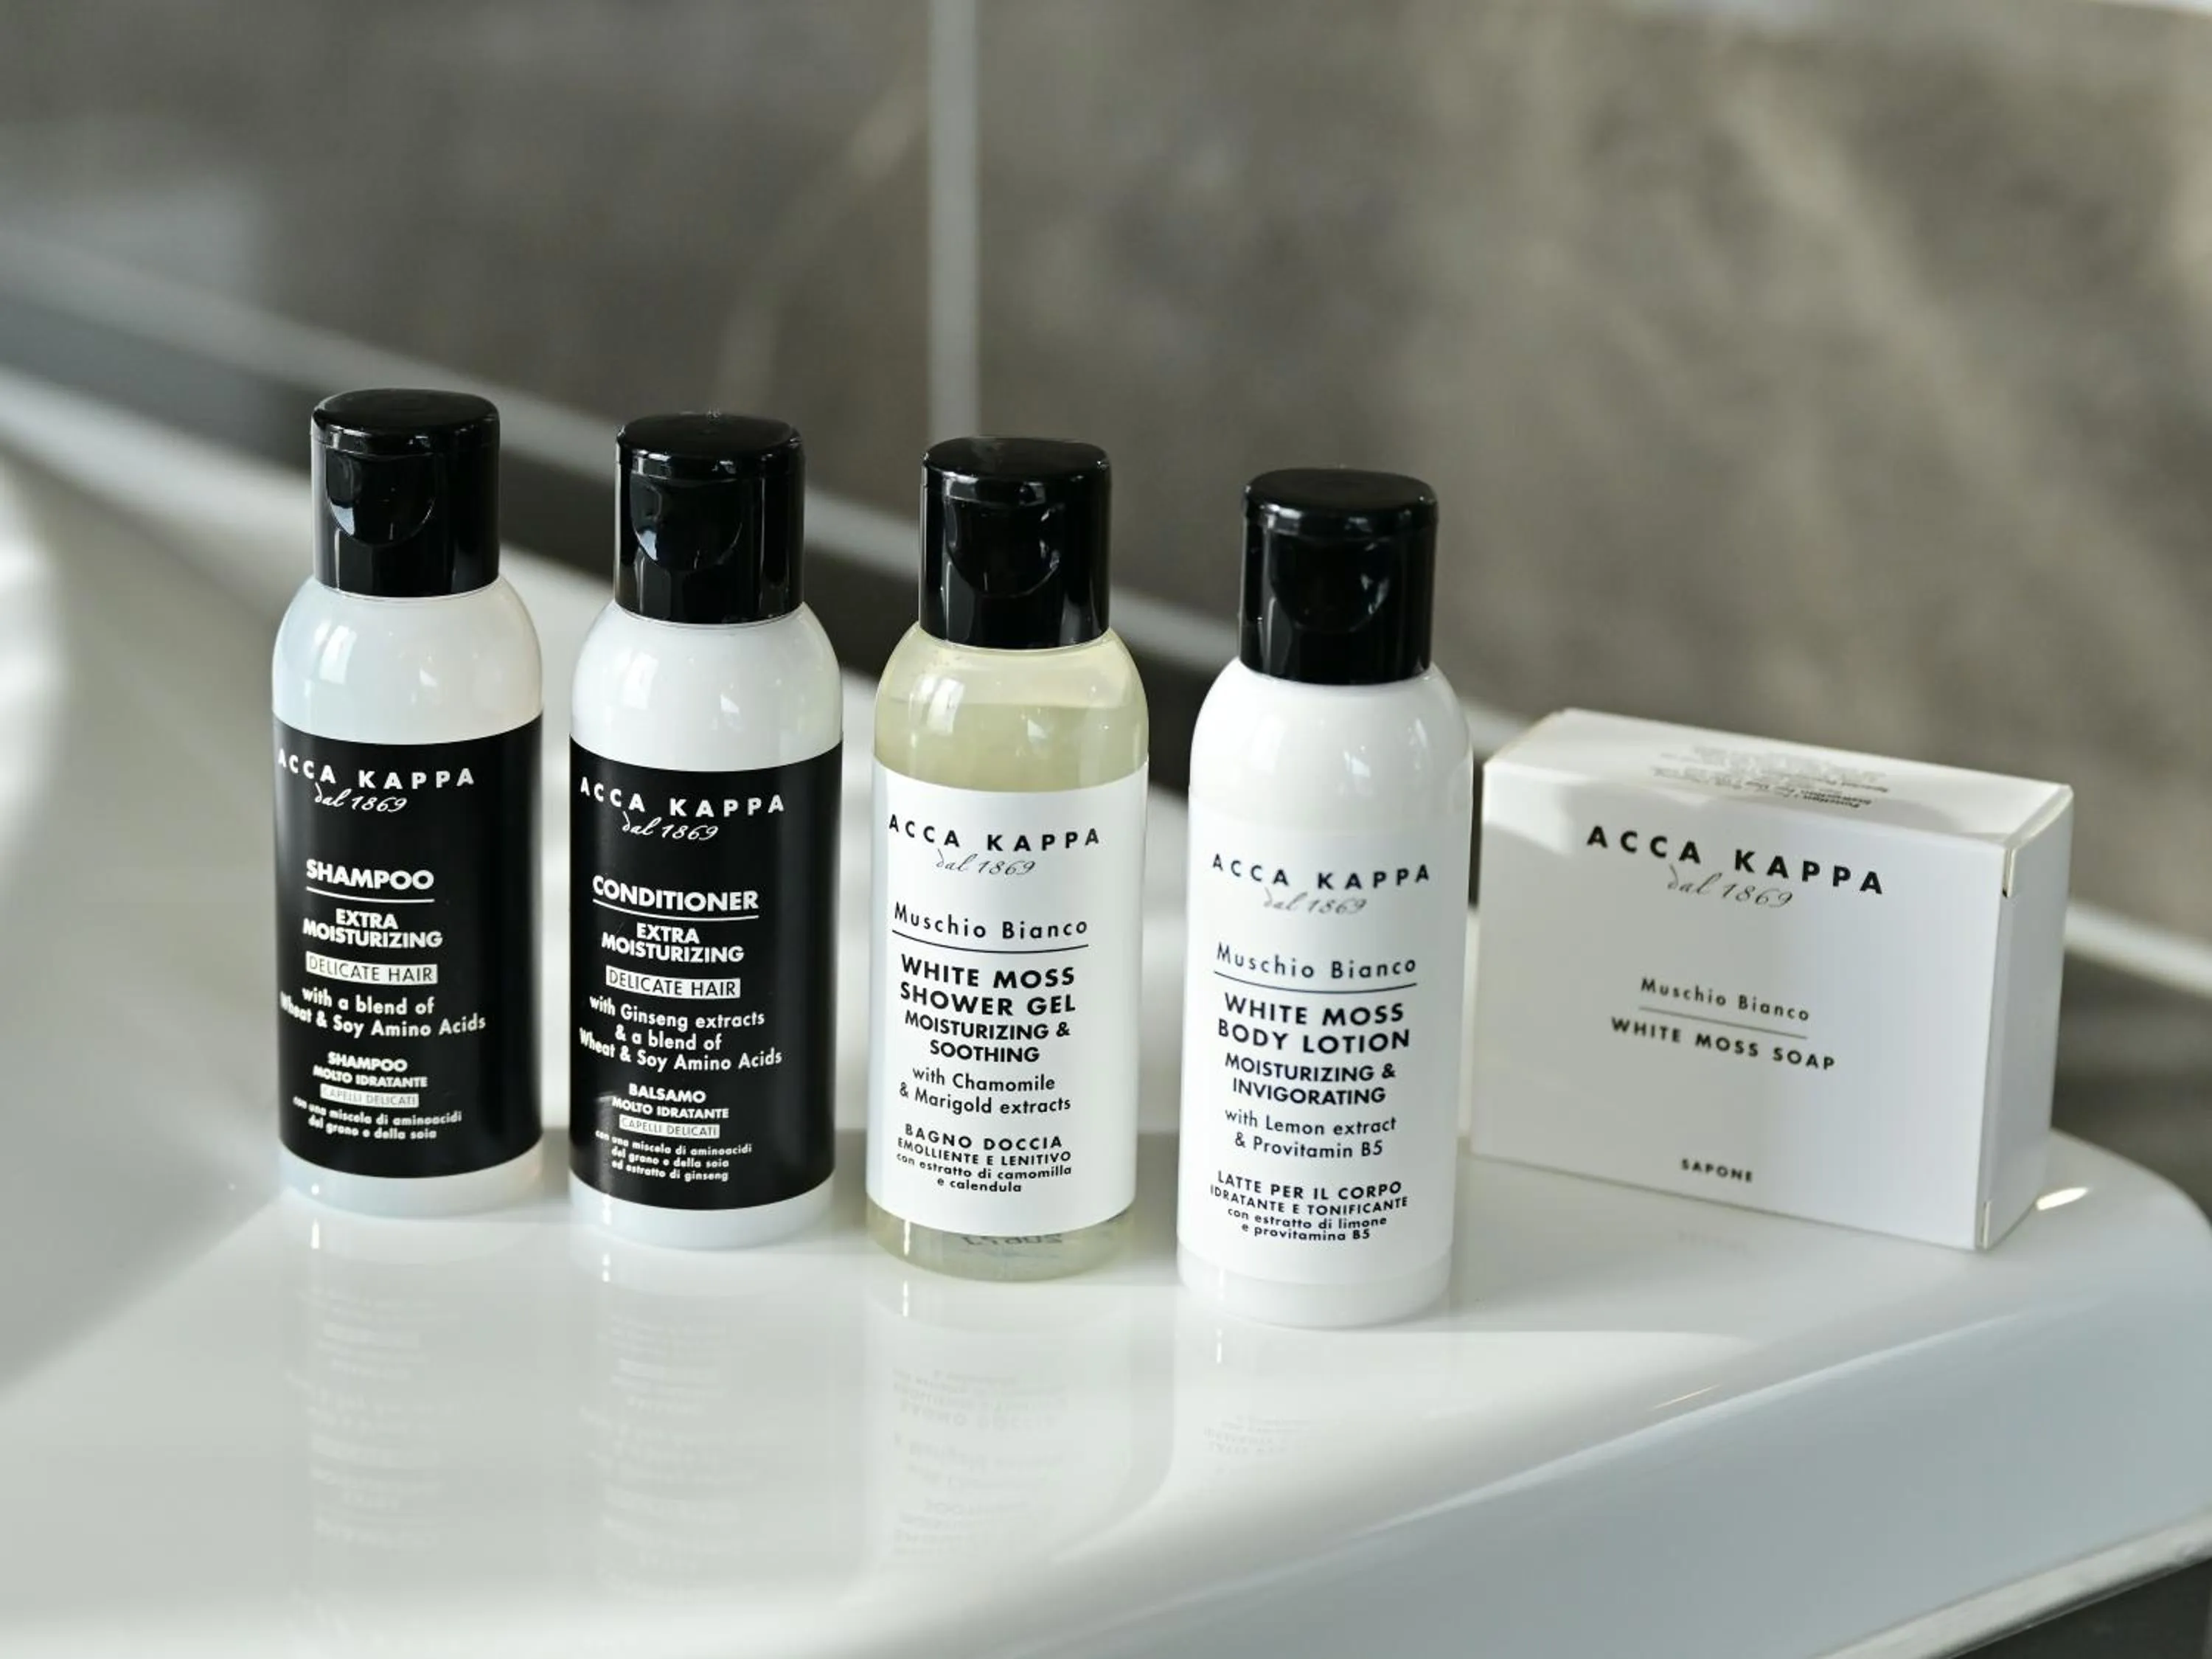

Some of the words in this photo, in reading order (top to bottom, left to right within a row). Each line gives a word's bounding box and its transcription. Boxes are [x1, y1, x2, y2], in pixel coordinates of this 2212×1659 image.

[277, 748, 336, 784] ACCA
[358, 768, 474, 789] KAPPA
[314, 782, 352, 808] dal
[352, 796, 407, 812] 1869
[580, 777, 645, 812] ACCA
[669, 795, 785, 818] KAPPA
[622, 811, 662, 836] dal
[661, 824, 719, 841] 1869
[889, 814, 960, 847] ACCA
[987, 828, 1099, 851] KAPPA
[936, 849, 978, 872] dal
[978, 860, 1036, 875] 1869
[1212, 853, 1289, 886] ACCA
[1318, 864, 1430, 889] KAPPA
[1587, 825, 1701, 865] ACCA
[1734, 848, 1884, 895] KAPPA
[306, 859, 434, 890] SHAMPOO
[1666, 865, 1722, 896] dal
[1722, 881, 1794, 908] 1869
[593, 875, 759, 911] CONDITIONER
[1308, 898, 1367, 914] 1869
[336, 908, 398, 929] EXTRA
[894, 902, 986, 939] Muschio
[1003, 922, 1087, 939] Bianco
[302, 918, 443, 948] MOISTURIZING
[637, 922, 700, 944] EXTRA
[602, 933, 744, 963] MOISTURIZING
[1217, 942, 1314, 978] Muschio
[1331, 959, 1416, 978] Bianco
[309, 954, 380, 981] DELICATE
[389, 967, 433, 982] HAIR
[609, 967, 683, 997] DELICATE
[691, 982, 736, 997] HAIR
[901, 953, 979, 987] WHITE
[993, 967, 1075, 989] MOSS
[302, 987, 332, 1008] with
[338, 999, 348, 1011] a
[355, 995, 407, 1015] blend
[415, 997, 434, 1015] of
[900, 981, 1013, 1015] SHOWER
[1027, 994, 1075, 1015] GEL
[1225, 992, 1307, 1025] WHITE
[1322, 1003, 1404, 1026] MOSS
[1641, 976, 1726, 1006] Muschio
[1738, 993, 1811, 1022] Bianco
[316, 1011, 327, 1029] &
[333, 1015, 364, 1038] Soy
[371, 1020, 431, 1037] Amino
[439, 1013, 486, 1035] Acids
[590, 995, 615, 1016] with
[621, 1004, 688, 1032] Ginseng
[695, 1012, 765, 1029] extracts
[905, 1009, 1049, 1040] MOISTURIZING
[1056, 1021, 1071, 1037] &
[580, 1027, 615, 1058] Wheat
[621, 1046, 631, 1062] &
[637, 1049, 667, 1072] Soy
[674, 1054, 731, 1071] Amino
[738, 1048, 782, 1068] Acids
[615, 1024, 626, 1041] &
[633, 1034, 641, 1045] a
[648, 1029, 697, 1050] blend
[703, 1033, 722, 1050] of
[1219, 1018, 1288, 1050] BODY
[1304, 1029, 1409, 1054] LOTION
[1612, 1017, 1682, 1043] WHITE
[1696, 1034, 1759, 1058] MOSS
[1773, 1046, 1835, 1071] SOAP
[328, 1051, 408, 1072] SHAMPOO
[930, 1040, 1040, 1062] SOOTHING
[313, 1065, 352, 1084] MOLTO
[355, 1074, 428, 1088] IDRATANTE
[913, 1068, 945, 1085] with
[953, 1073, 1055, 1092] Chamomile
[1225, 1052, 1374, 1082] MOISTURIZING
[1382, 1062, 1396, 1079] &
[629, 1083, 706, 1103] BALSAMO
[900, 1082, 909, 1098] &
[915, 1087, 992, 1115] Marigold
[1000, 1097, 1071, 1114] extracts
[1233, 1077, 1386, 1105] INVIGORATING
[376, 1113, 388, 1125] di
[392, 1110, 462, 1126] aminoacidi
[612, 1097, 653, 1116] MOLTO
[657, 1106, 729, 1119] IDRATANTE
[1225, 1108, 1257, 1127] with
[1267, 1115, 1324, 1135] Lemon
[1333, 1117, 1397, 1135] extract
[308, 1115, 324, 1130] del
[374, 1127, 406, 1139] della
[411, 1129, 437, 1139] soia
[622, 1117, 662, 1133] CAPELLI
[667, 1124, 717, 1136] DELICATI
[905, 1124, 972, 1148] BAGNO
[984, 1135, 1062, 1150] DOCCIA
[611, 1147, 625, 1158] del
[629, 1152, 659, 1166] grano
[674, 1155, 701, 1168] della
[706, 1158, 729, 1168] soia
[633, 1141, 672, 1155] miscela
[675, 1145, 686, 1155] di
[691, 1144, 752, 1155] aminoacidi
[898, 1138, 979, 1164] EMOLLIENTE
[987, 1155, 994, 1165] E
[1001, 1151, 1071, 1166] LENITIVO
[1235, 1133, 1245, 1147] &
[1253, 1135, 1353, 1158] Provitamin
[1361, 1139, 1382, 1156] B5
[611, 1161, 623, 1170] ed
[627, 1164, 666, 1178] estratto
[669, 1168, 681, 1178] di
[685, 1171, 729, 1182] ginseng
[897, 1152, 915, 1165] con
[919, 1160, 971, 1178] estratto
[978, 1168, 992, 1179] di
[998, 1165, 1071, 1180] camomilla
[1682, 1158, 1754, 1183] SAPONE
[937, 1178, 944, 1186] e
[950, 1179, 1022, 1192] calendula
[1218, 1170, 1262, 1194] LATTE
[1270, 1183, 1304, 1199] PER
[1313, 1188, 1329, 1200] IL
[1338, 1180, 1402, 1200] CORPO
[1210, 1184, 1285, 1213] IDRATANTE
[1293, 1204, 1299, 1214] E
[1307, 1197, 1408, 1216] TONIFICANTE
[1228, 1208, 1248, 1220] con
[1254, 1214, 1312, 1229] estratto
[1318, 1219, 1332, 1229] di
[1338, 1216, 1387, 1229] limone
[1242, 1223, 1248, 1232] e
[1254, 1227, 1346, 1242] provitamina
[1352, 1230, 1370, 1240] B5
